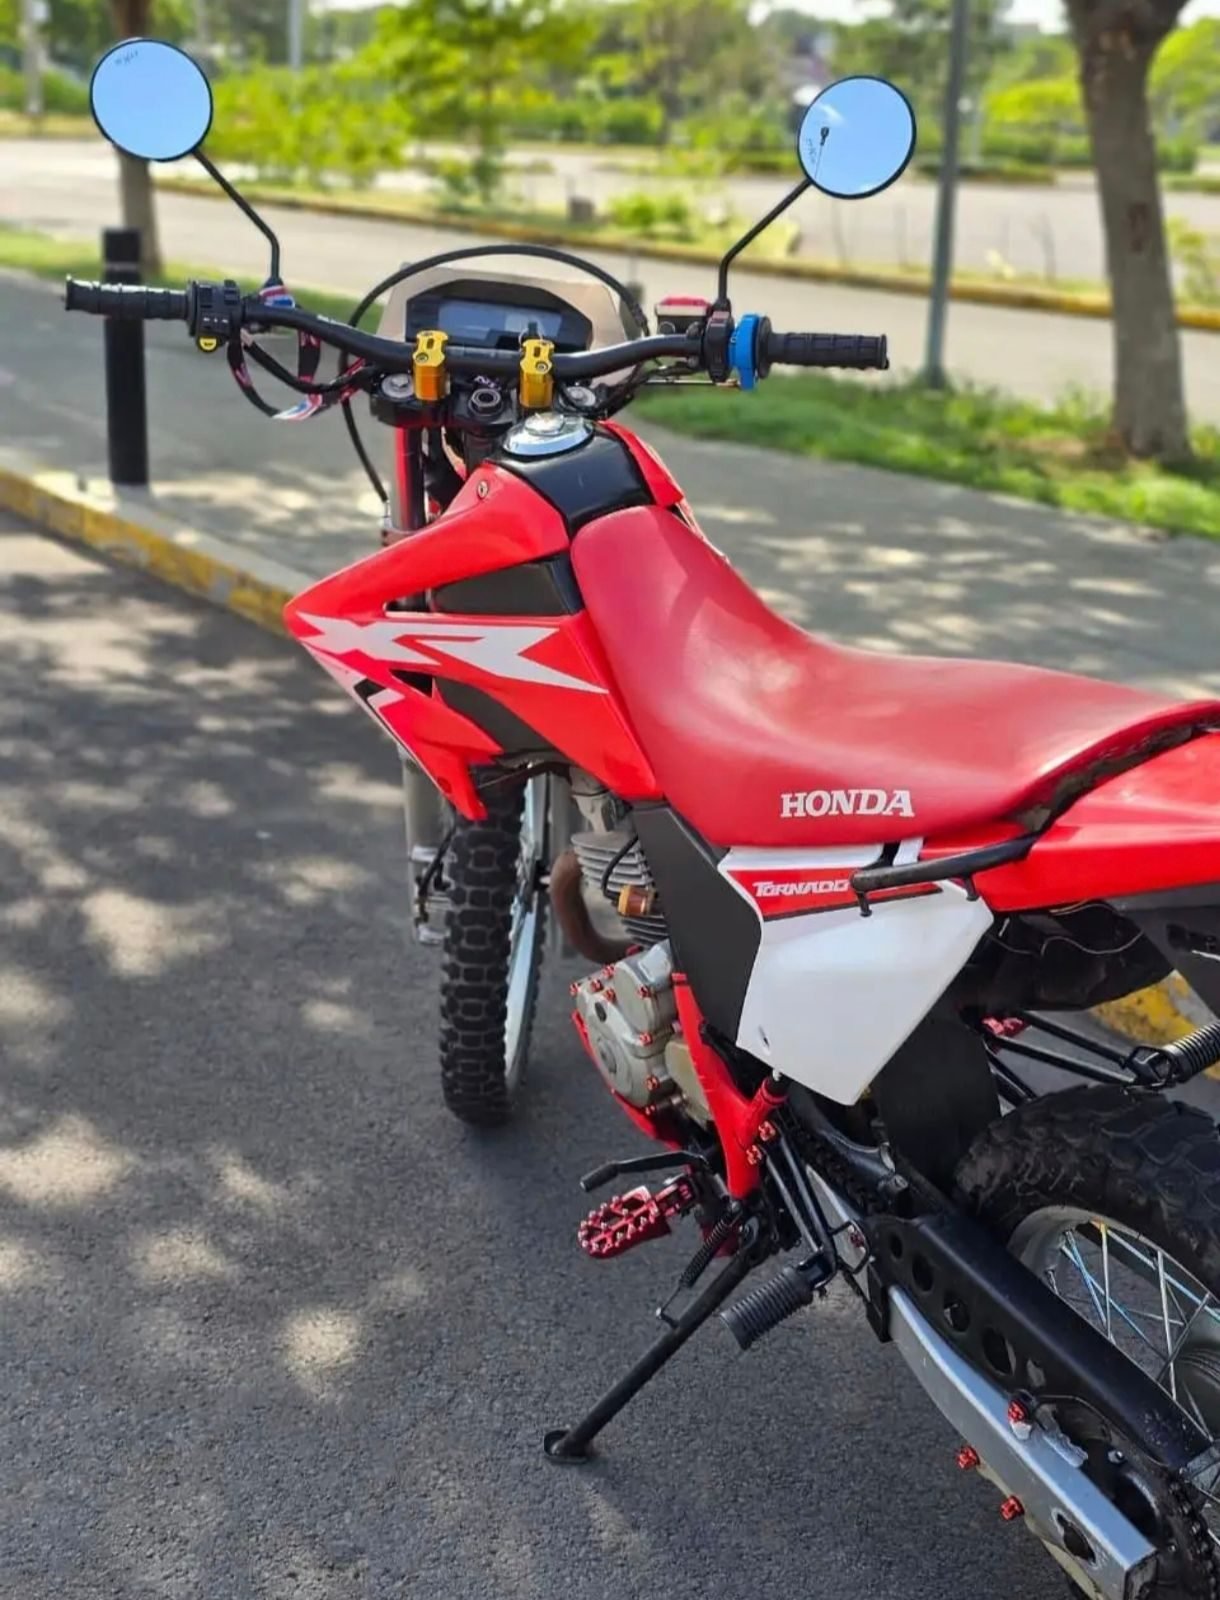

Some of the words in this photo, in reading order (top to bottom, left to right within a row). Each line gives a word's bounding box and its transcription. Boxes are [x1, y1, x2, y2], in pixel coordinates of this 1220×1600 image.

[296, 611, 609, 694] XR
[780, 788, 915, 818] HONDA
[752, 879, 850, 897] TORNADO
